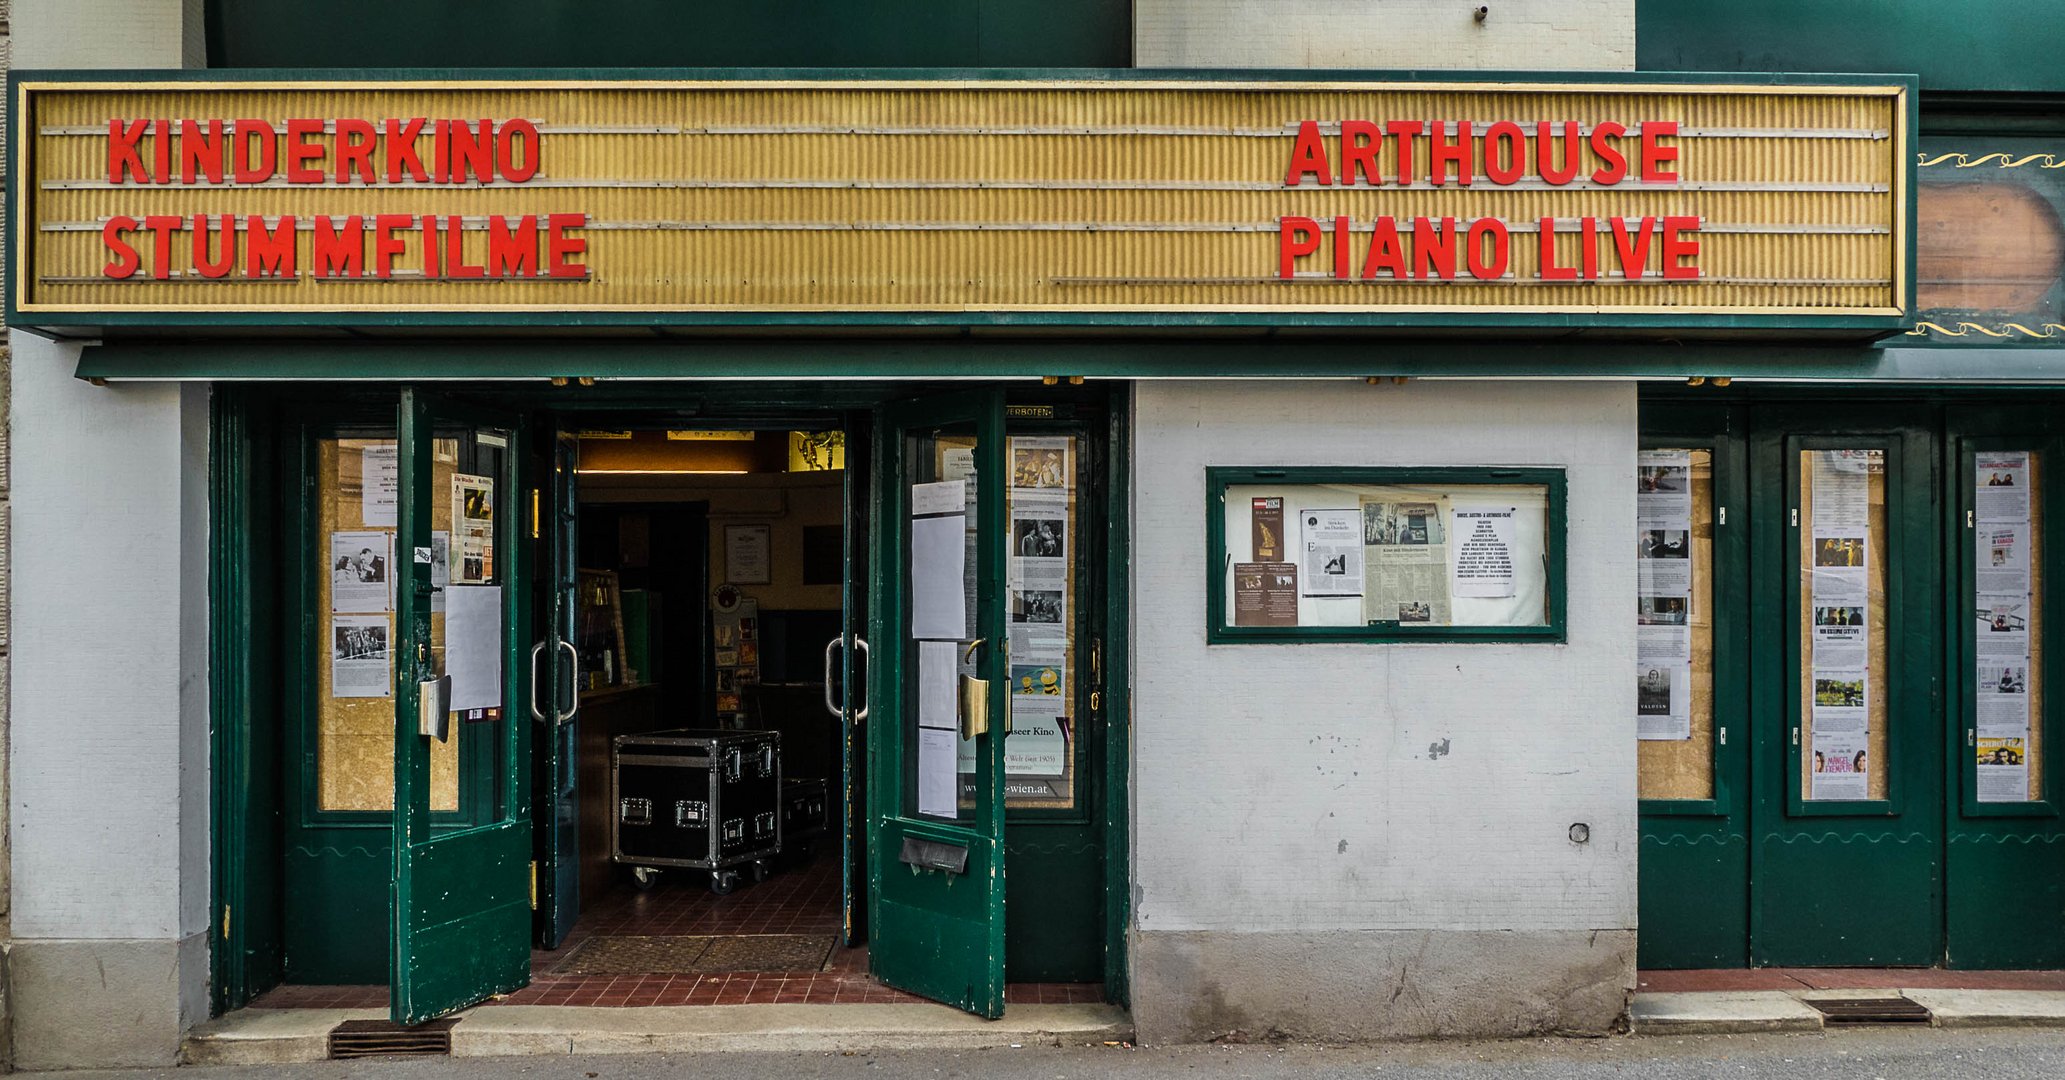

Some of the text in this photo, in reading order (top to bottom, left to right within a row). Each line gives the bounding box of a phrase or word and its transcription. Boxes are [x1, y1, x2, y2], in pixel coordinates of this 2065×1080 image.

[109, 117, 541, 185] KINDERKINO
[1285, 120, 1679, 186] ARTHOUSE
[102, 213, 587, 280] STUMMFILME
[1280, 216, 1701, 280] PIANO LIVE
[1010, 754, 1023, 762] Welt
[1033, 726, 1054, 736] Kino
[1006, 783, 1047, 794] -wien.at
